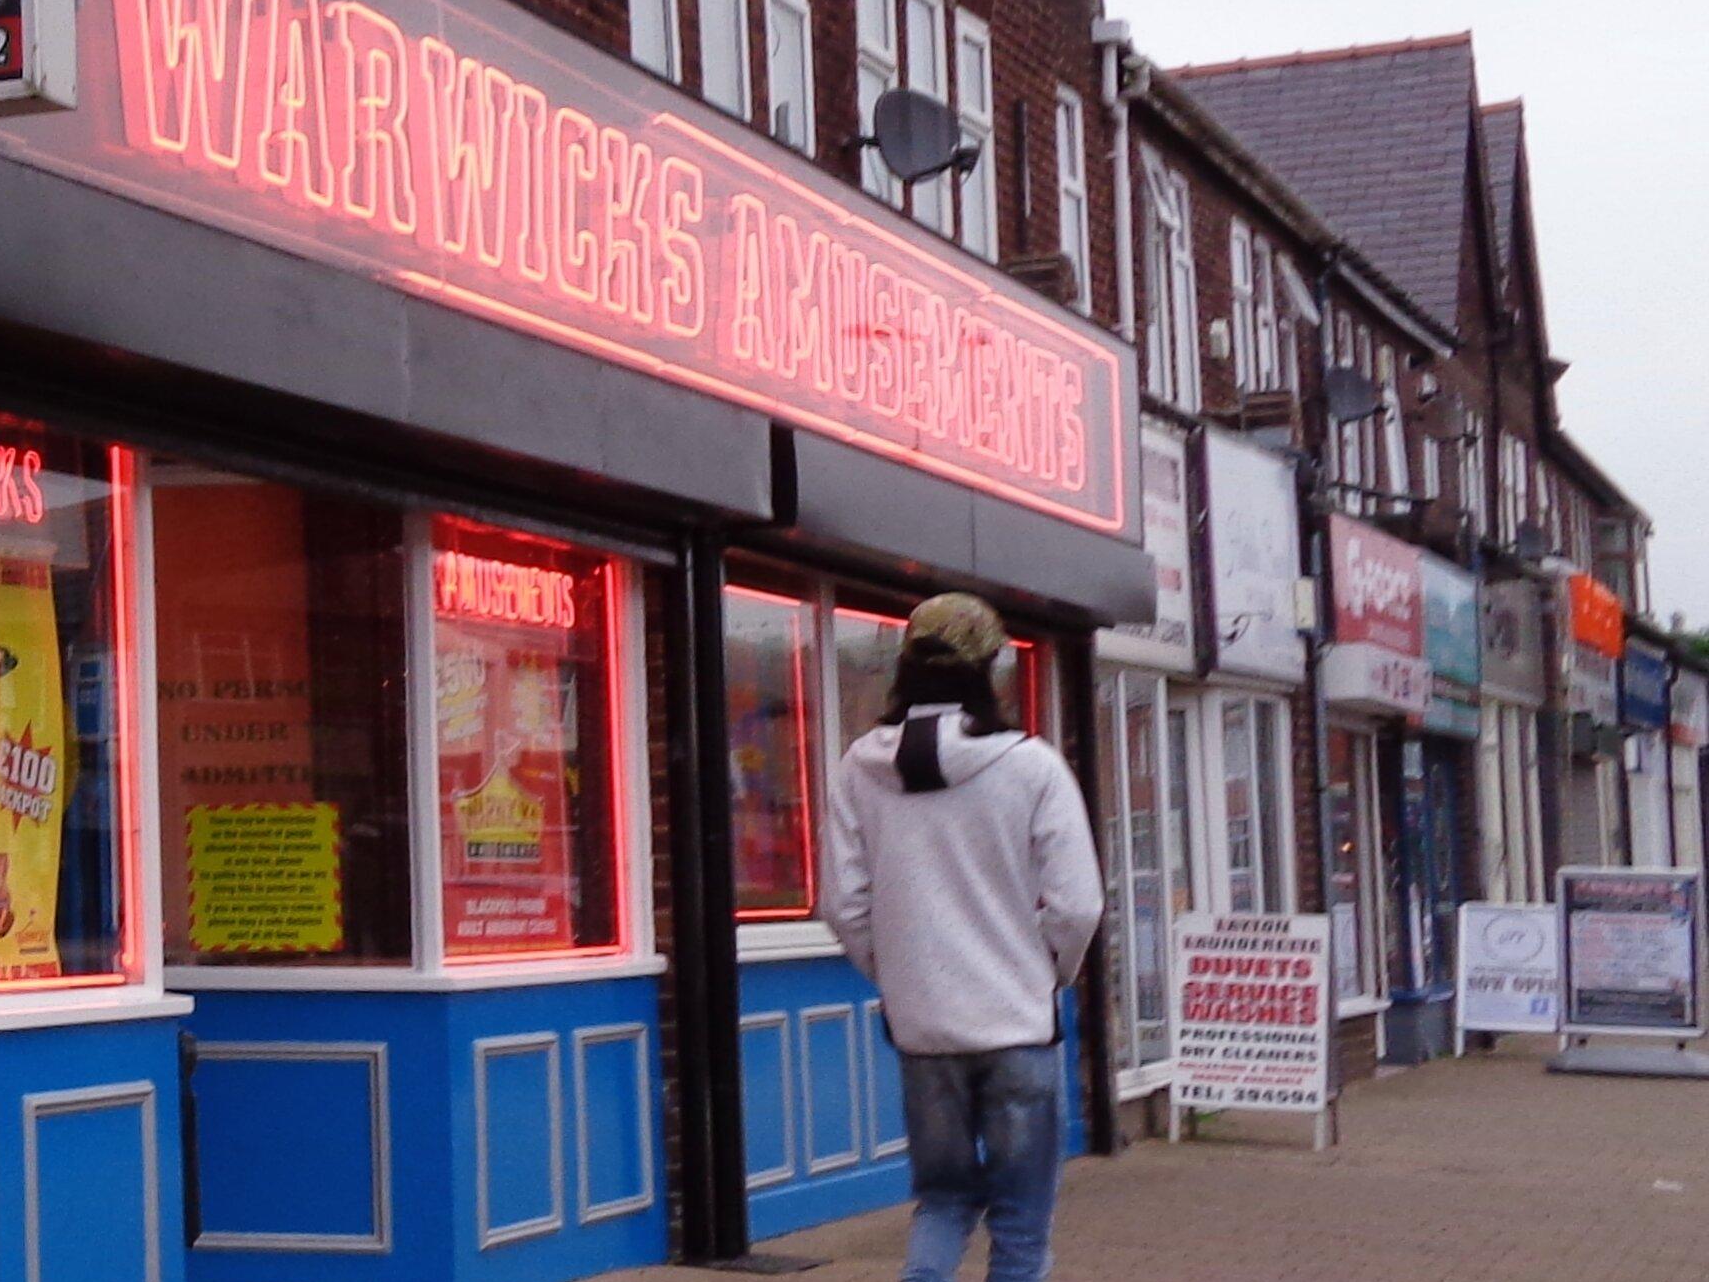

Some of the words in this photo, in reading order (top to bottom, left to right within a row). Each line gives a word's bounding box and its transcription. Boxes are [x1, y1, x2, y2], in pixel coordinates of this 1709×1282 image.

[728, 192, 1086, 492] AMUSEMENTS
[1188, 955, 1313, 978] DUVETS
[1183, 981, 1319, 1003] SERVICE
[1183, 1002, 1319, 1026] WASHES
